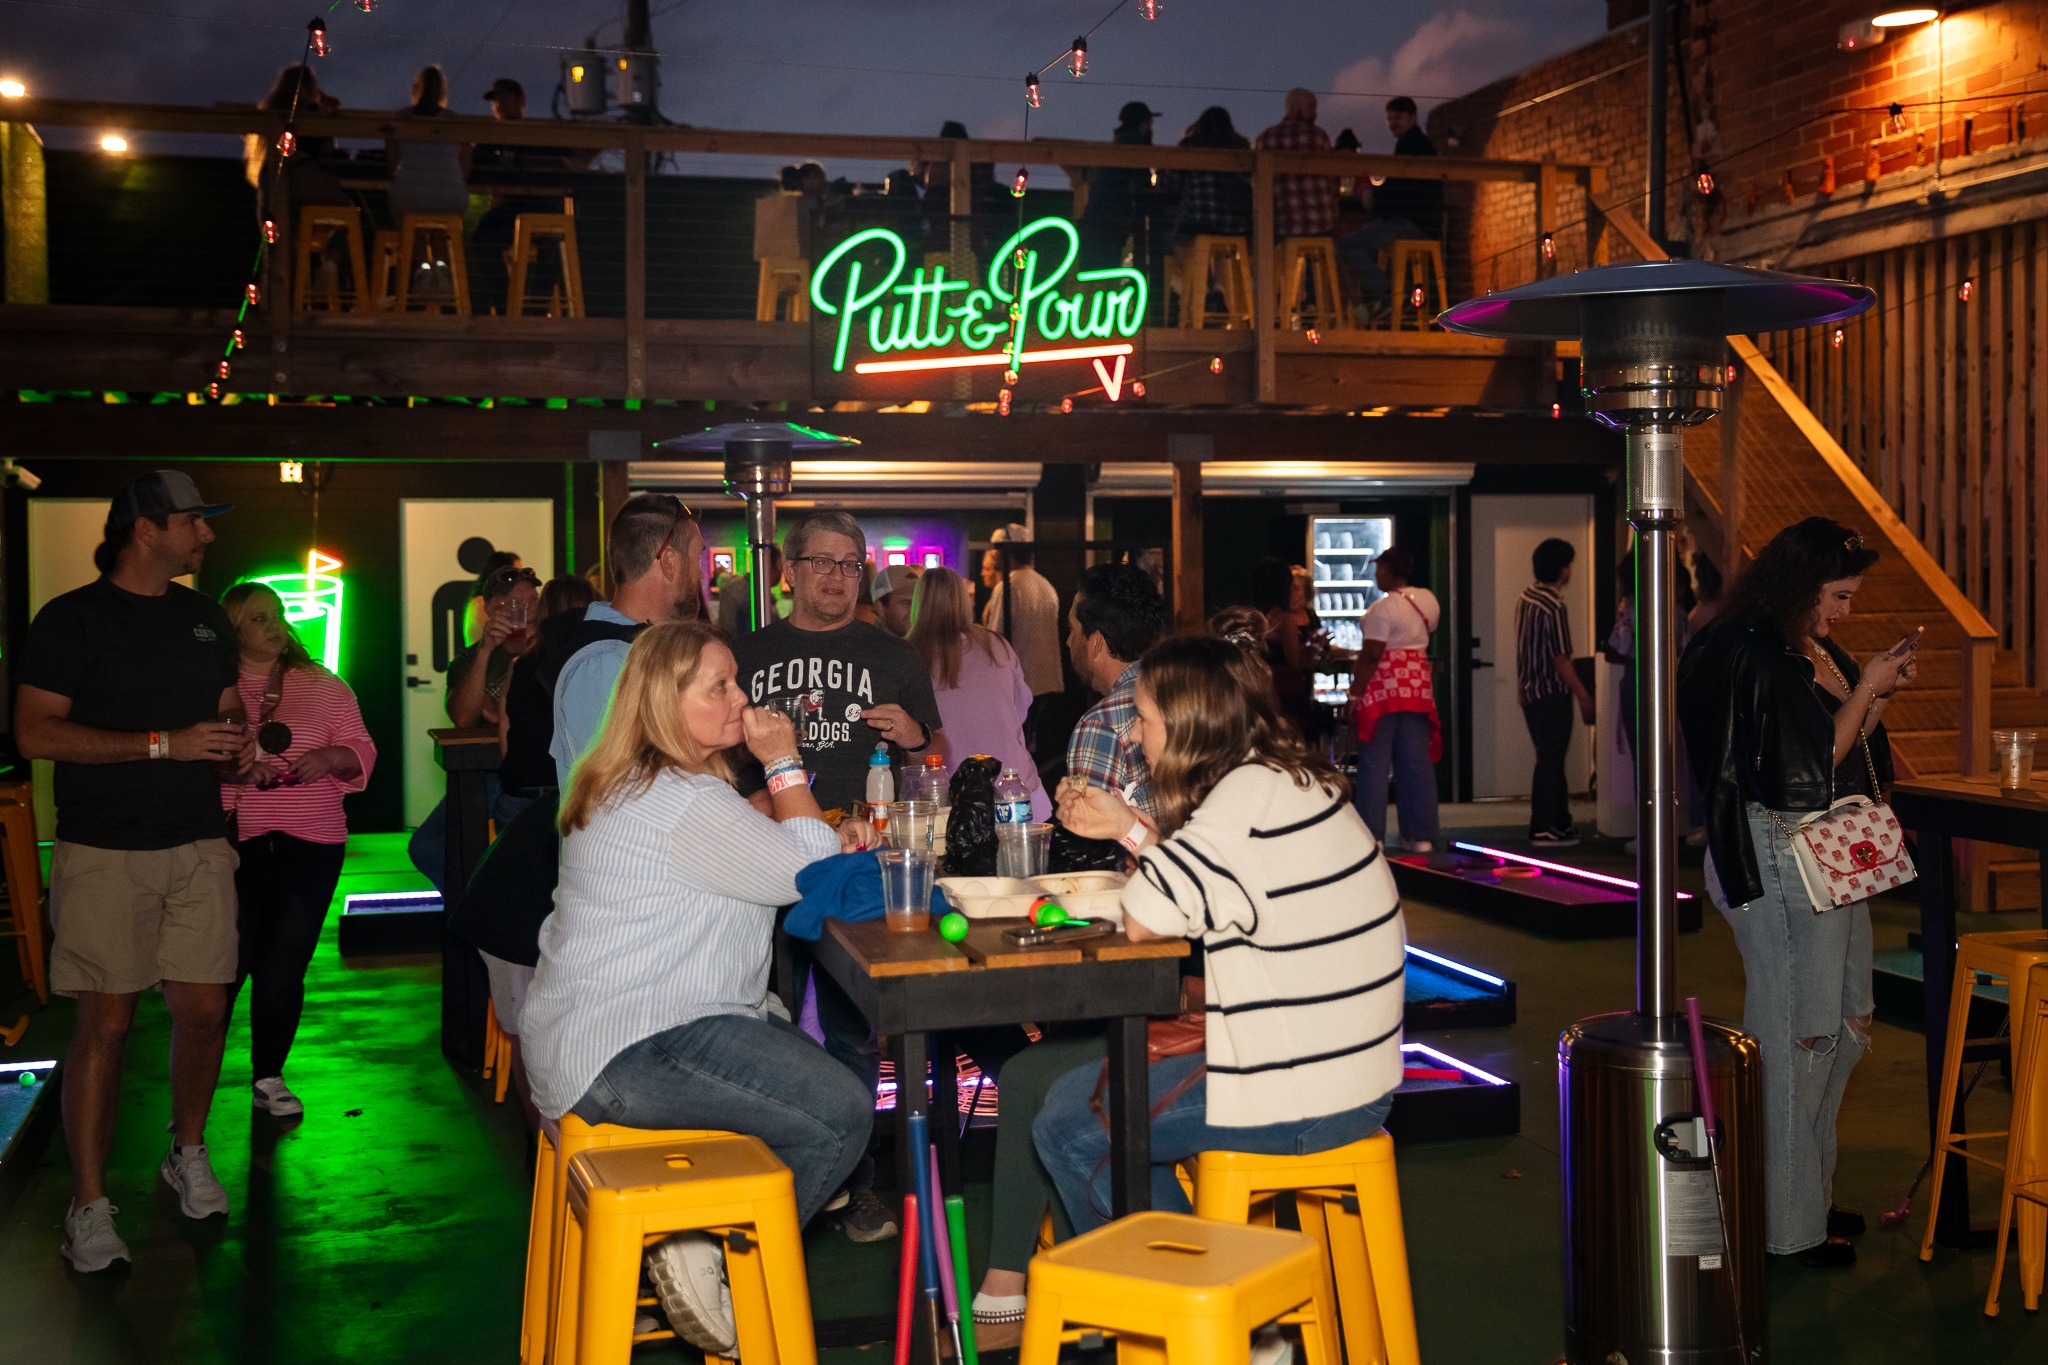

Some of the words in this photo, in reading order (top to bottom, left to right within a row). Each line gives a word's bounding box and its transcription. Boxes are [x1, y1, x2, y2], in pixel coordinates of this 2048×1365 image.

[810, 228, 970, 372] Putt
[945, 288, 1010, 350] &
[988, 216, 1149, 373] Pour
[751, 657, 873, 704] GEORGIA
